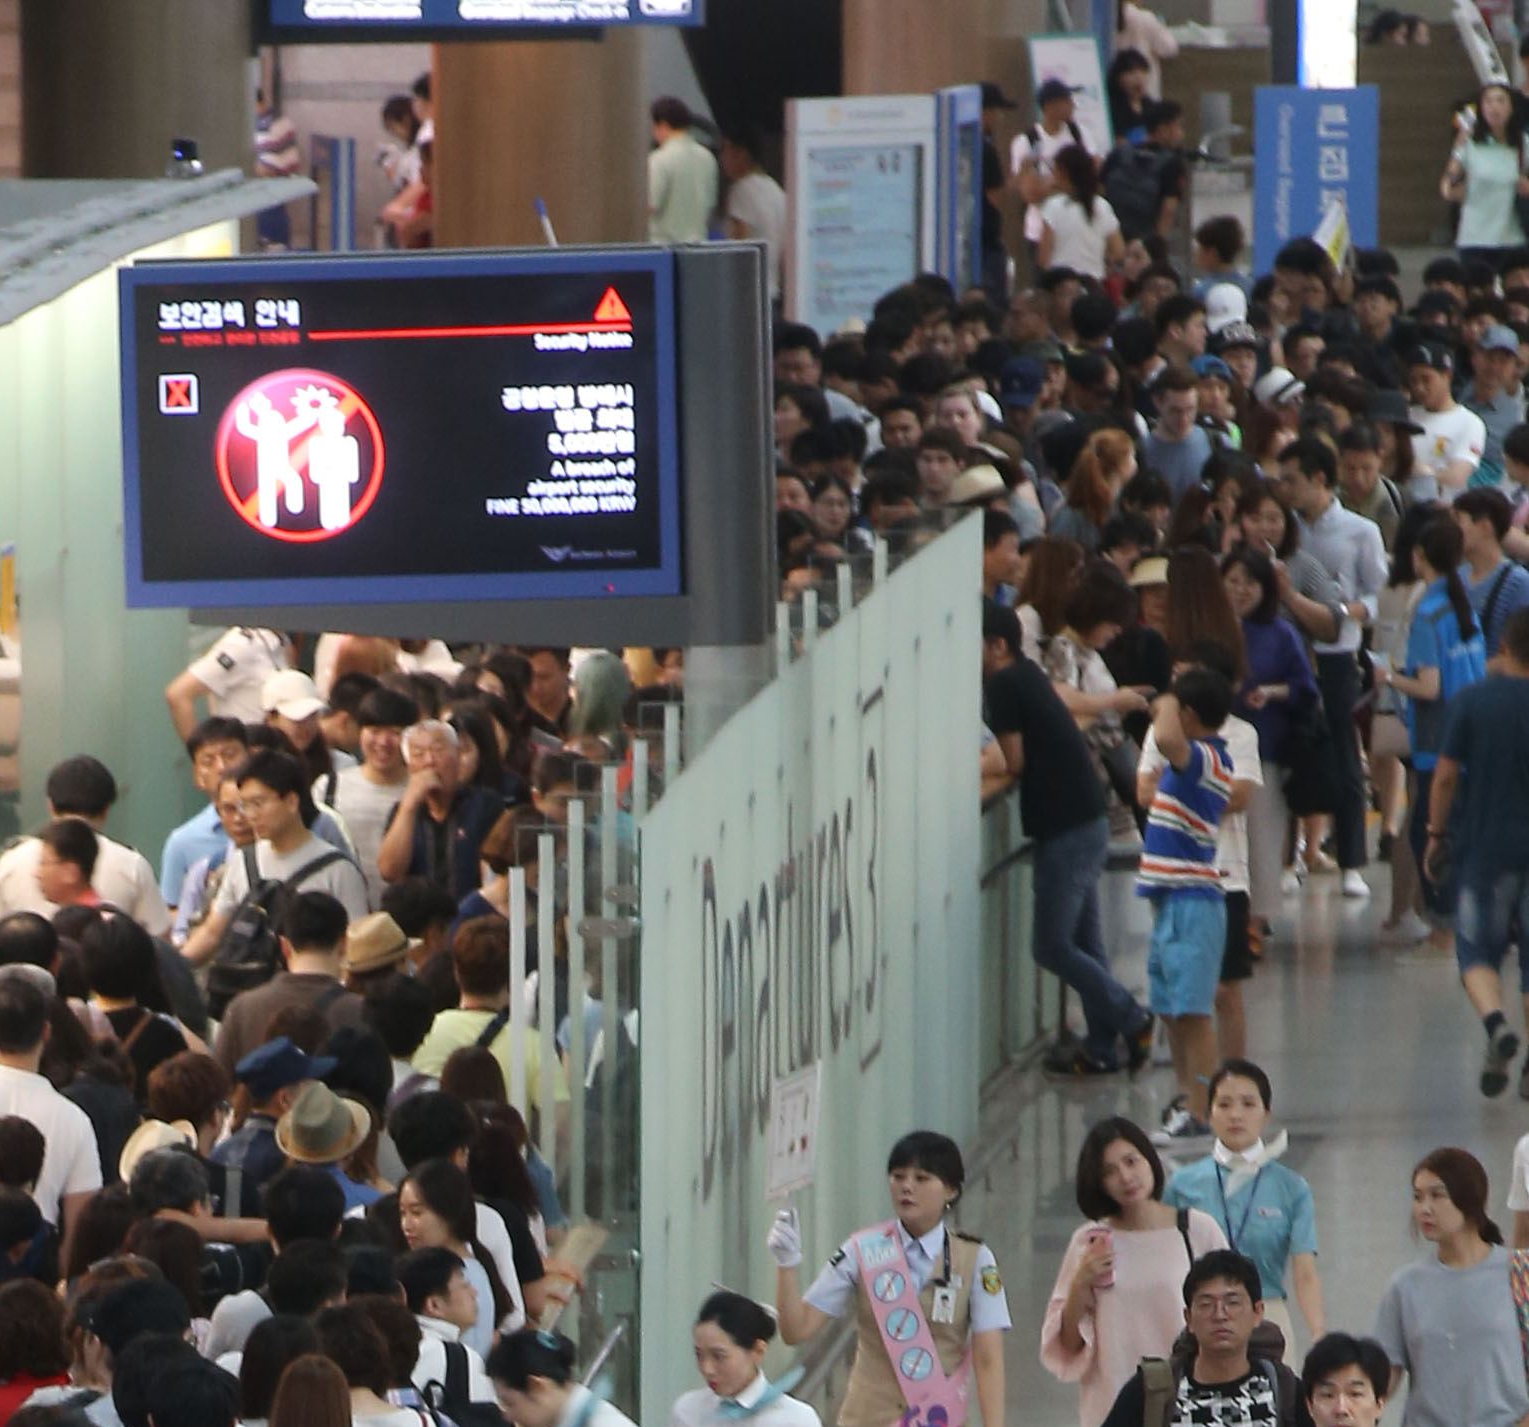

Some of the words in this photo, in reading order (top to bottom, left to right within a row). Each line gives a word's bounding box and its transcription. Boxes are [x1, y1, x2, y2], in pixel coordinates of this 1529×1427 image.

[255, 299, 301, 328] 안내
[532, 332, 588, 353] Security
[588, 331, 634, 350] Notice
[549, 460, 566, 478] A
[485, 497, 521, 517] FINE
[702, 797, 853, 1203] Departures
